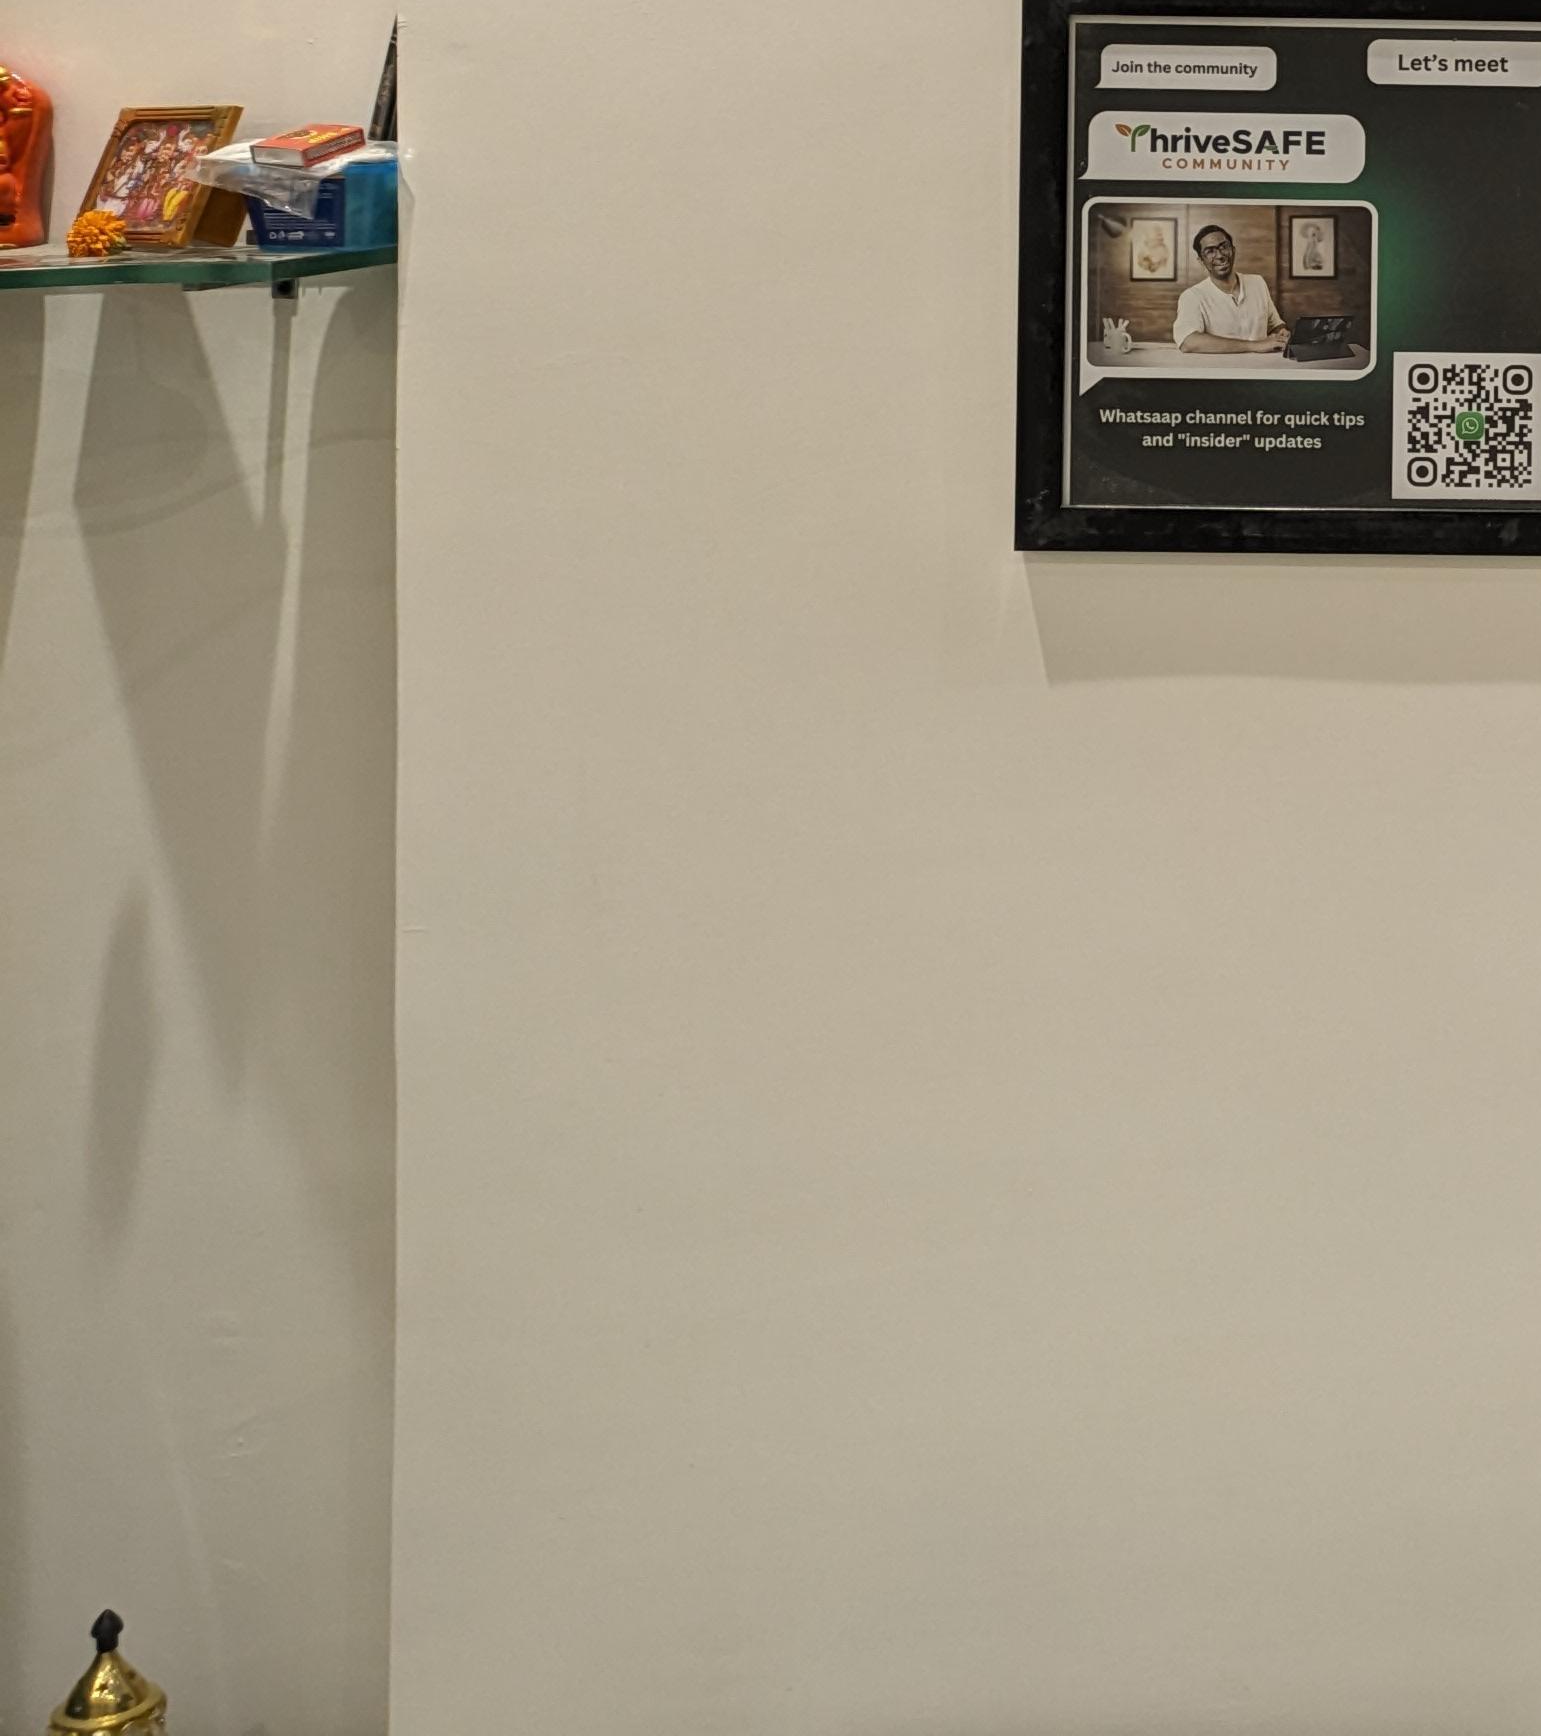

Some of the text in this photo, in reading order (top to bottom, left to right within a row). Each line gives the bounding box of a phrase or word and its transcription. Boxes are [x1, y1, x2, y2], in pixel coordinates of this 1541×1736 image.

[1112, 60, 1258, 78] Join the community
[1398, 54, 1509, 73] Let's meet
[1162, 158, 1290, 171] COMMUNITY
[1099, 409, 1365, 429] Whatsaap channel for quick tips
[1142, 433, 1322, 451] and "insider" updates
